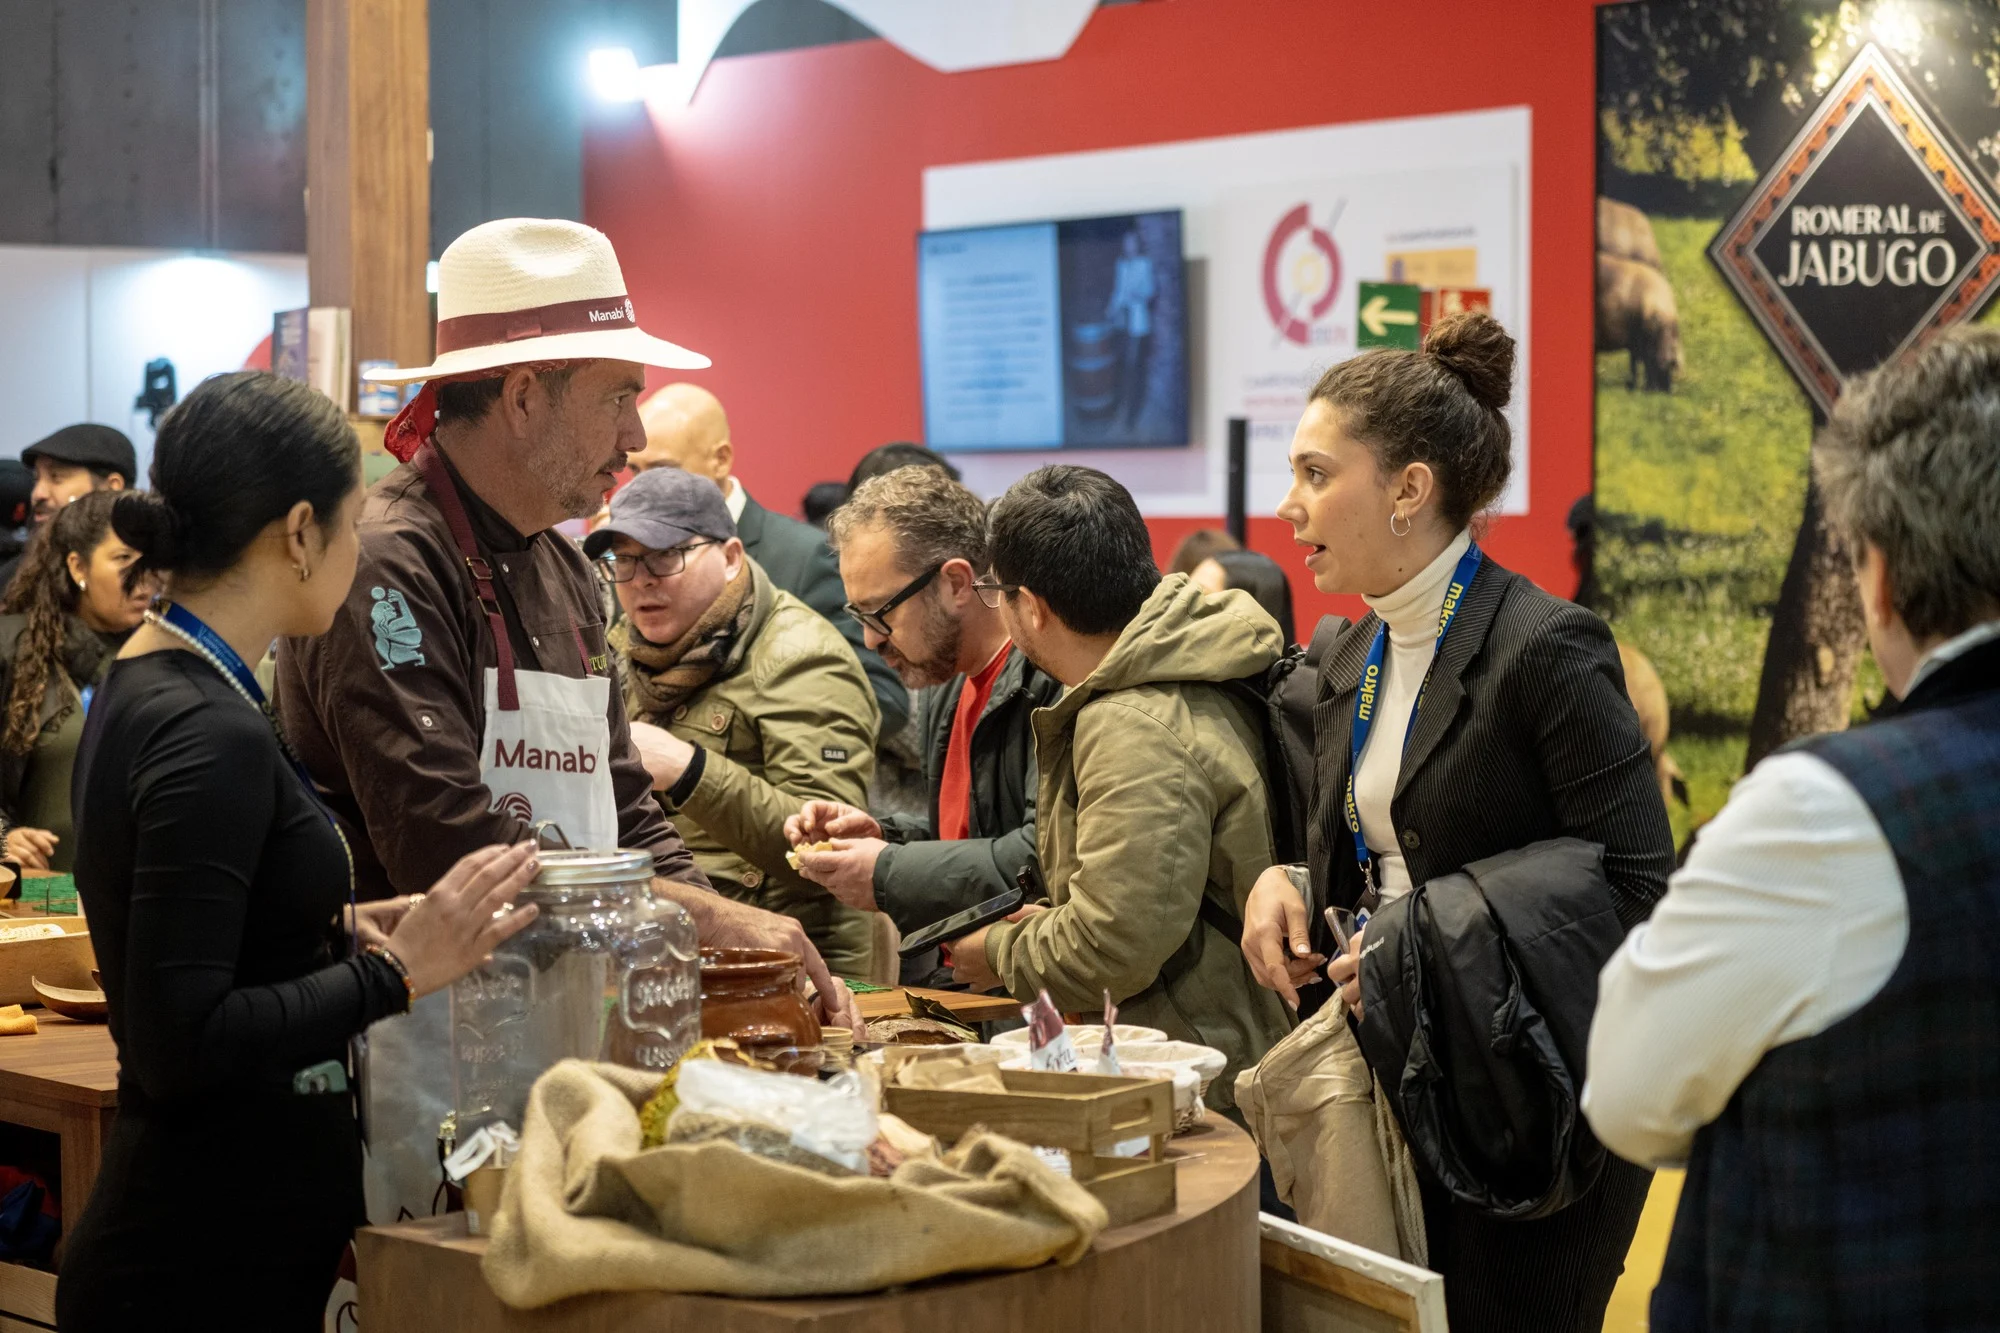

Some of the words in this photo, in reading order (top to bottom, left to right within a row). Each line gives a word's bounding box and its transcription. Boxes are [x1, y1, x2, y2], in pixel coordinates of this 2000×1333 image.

[1791, 203, 1917, 236] ROMERAL
[1918, 208, 1946, 234] DE
[1777, 237, 1957, 288] JABUGO
[588, 306, 624, 322] Manabí
[1437, 582, 1464, 638] makro
[1358, 664, 1379, 721] makro
[494, 738, 600, 774] Manab
